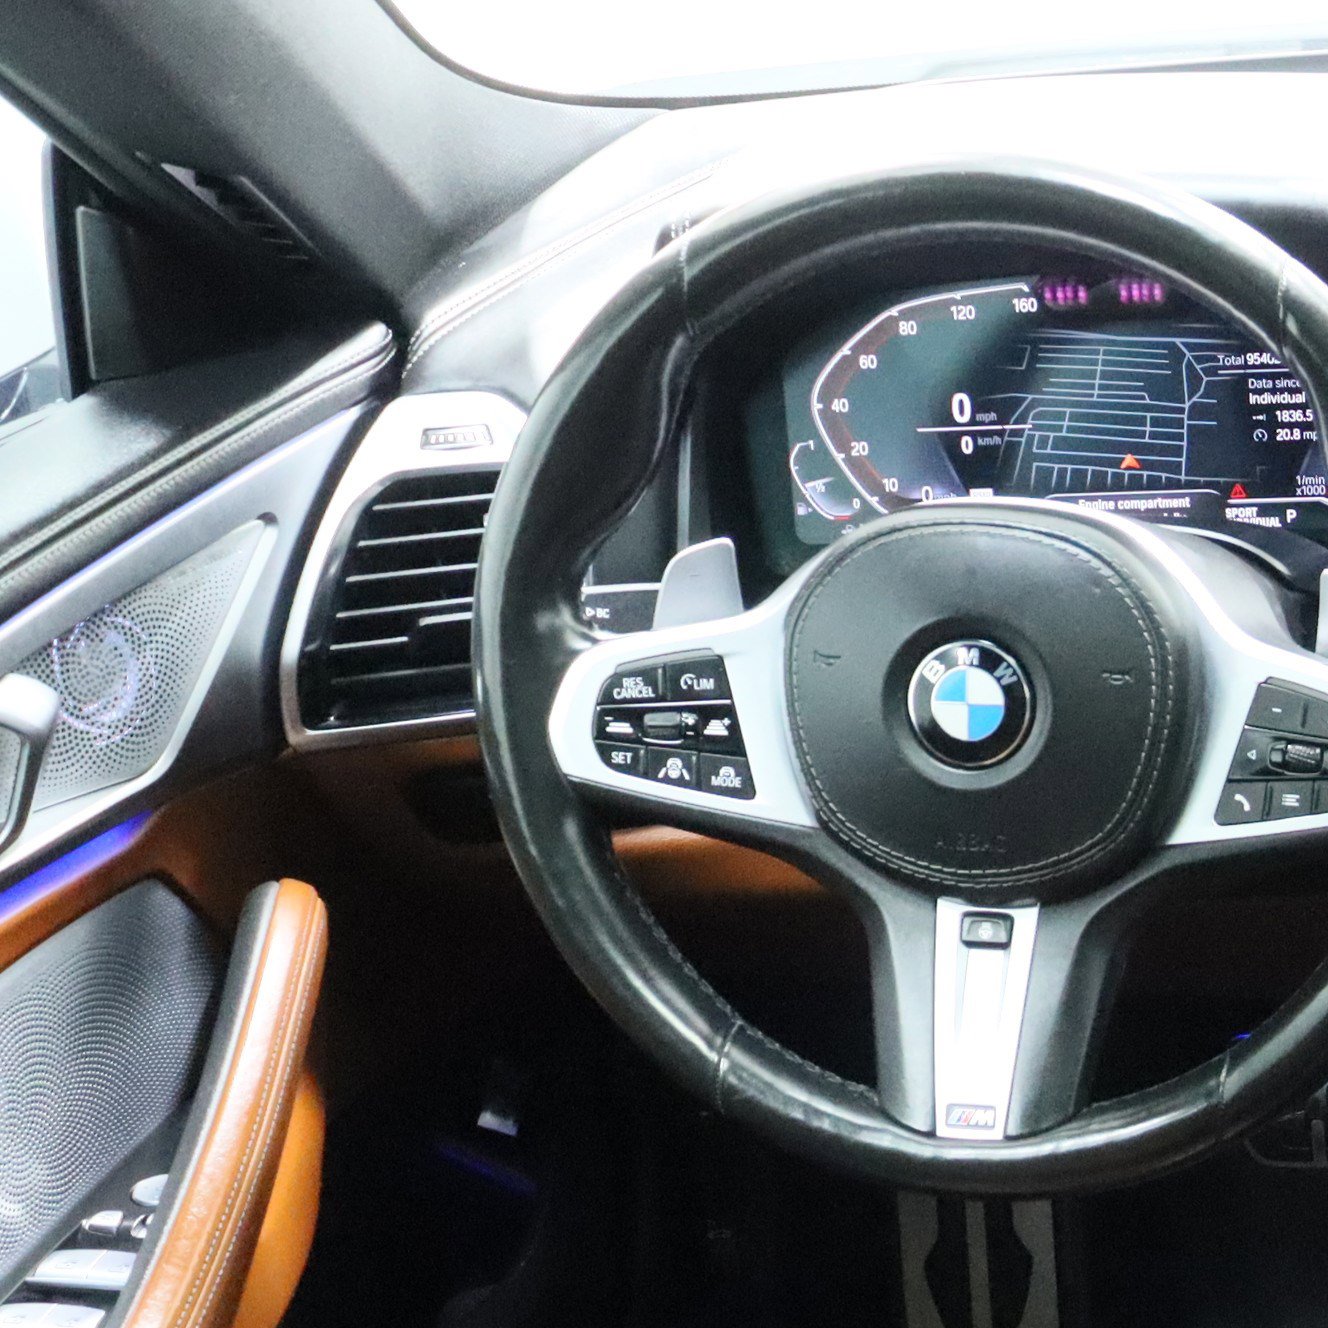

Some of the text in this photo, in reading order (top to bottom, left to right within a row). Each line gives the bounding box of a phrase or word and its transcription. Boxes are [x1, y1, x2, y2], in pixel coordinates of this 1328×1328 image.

[1013, 298, 1037, 313] 160
[950, 306, 975, 320] 120
[899, 321, 917, 336] 80
[859, 355, 877, 369] 60
[1218, 355, 1244, 365] Total
[1249, 379, 1272, 388] Data
[1249, 392, 1306, 404] Individual
[831, 399, 849, 412] 40
[951, 393, 972, 423] 0
[975, 411, 997, 423] mph
[1276, 409, 1313, 422] 1836.5
[1276, 429, 1300, 441] 20.8
[850, 442, 868, 456] 20
[961, 436, 1002, 454] 0 km/h
[883, 478, 898, 492] 10
[1296, 475, 1325, 485] 1/min
[921, 486, 933, 501] 0
[1296, 485, 1326, 495] x1000
[852, 499, 860, 508] 0
[1118, 497, 1191, 511] compartment
[1225, 507, 1258, 518] SPORT
[1286, 509, 1297, 523] P
[922, 647, 1018, 686] BMW
[622, 677, 644, 688] RES
[694, 678, 714, 690] LIM
[613, 687, 655, 699] CANCEL
[611, 752, 632, 764] SET
[711, 776, 742, 788] MODE
